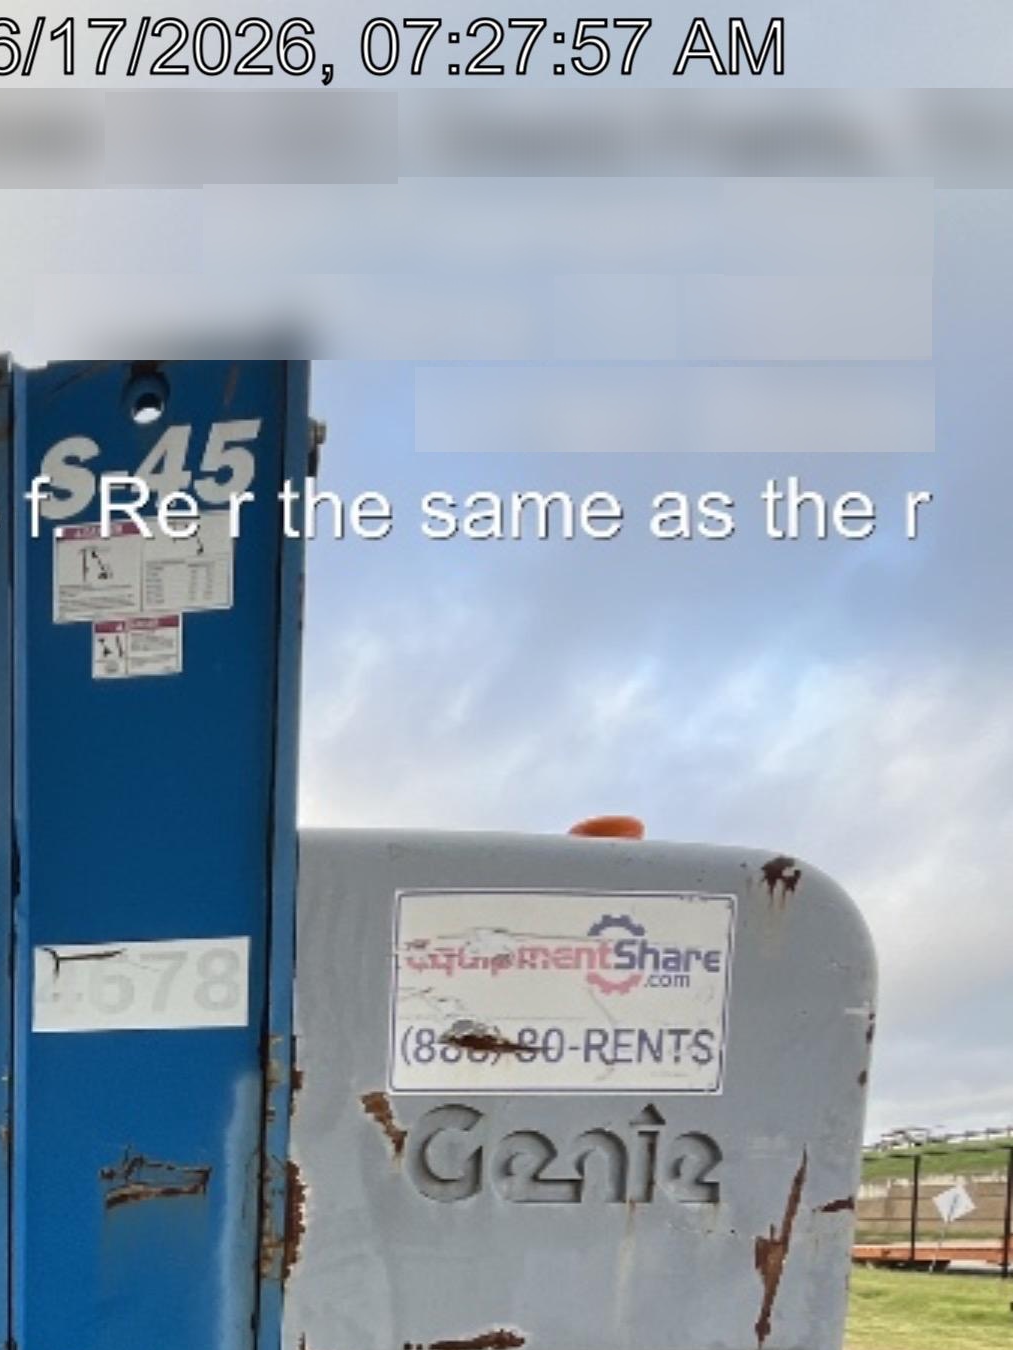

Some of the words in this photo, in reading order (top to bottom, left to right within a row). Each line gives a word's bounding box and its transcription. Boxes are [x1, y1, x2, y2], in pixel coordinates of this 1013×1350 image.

[40, 418, 262, 519] S-45
[643, 972, 691, 989] .com
[515, 1028, 716, 1066] 80-RENTS
[408, 1103, 723, 1203] Genie
